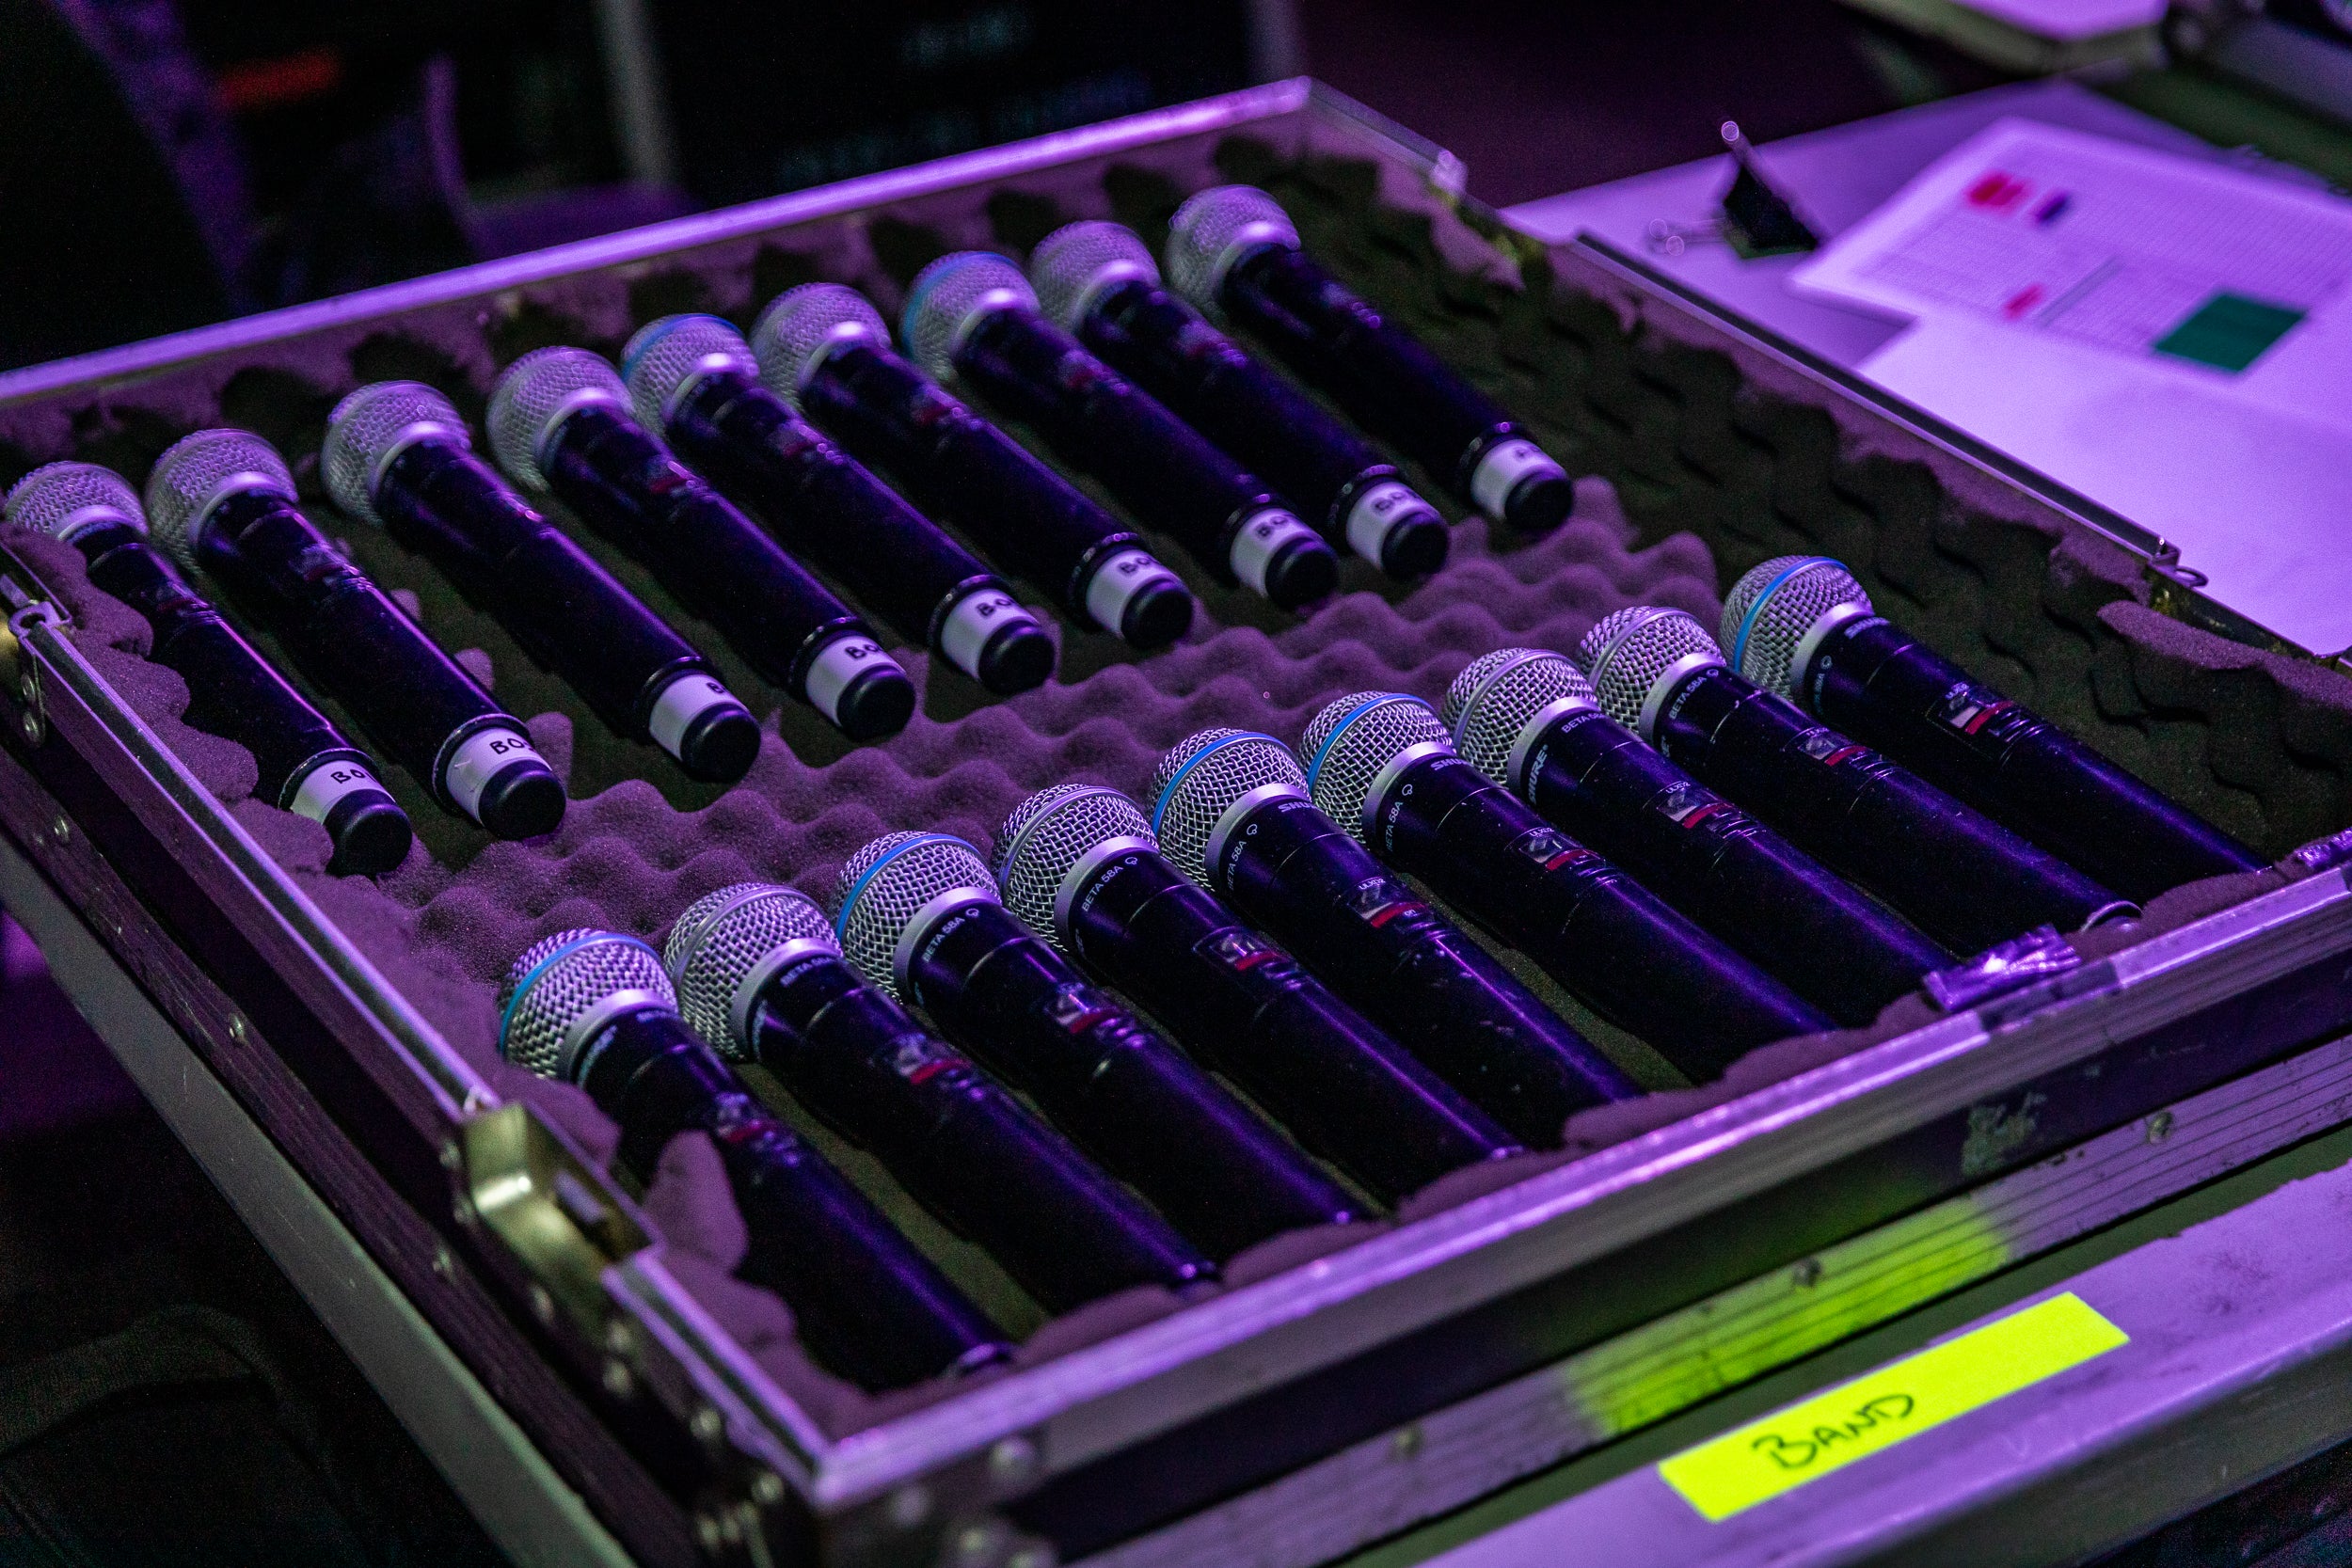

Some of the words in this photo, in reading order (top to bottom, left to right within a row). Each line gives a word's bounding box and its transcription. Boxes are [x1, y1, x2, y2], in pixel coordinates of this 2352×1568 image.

[1561, 715, 1592, 734] BETA
[1388, 800, 1405, 824] 58A
[1232, 840, 1248, 863] 58A
[1081, 882, 1105, 912] BETA
[1101, 865, 1125, 882] 58A
[921, 933, 946, 964] BETA
[942, 916, 966, 934] 58A
[1753, 1394, 1914, 1469] BAND
